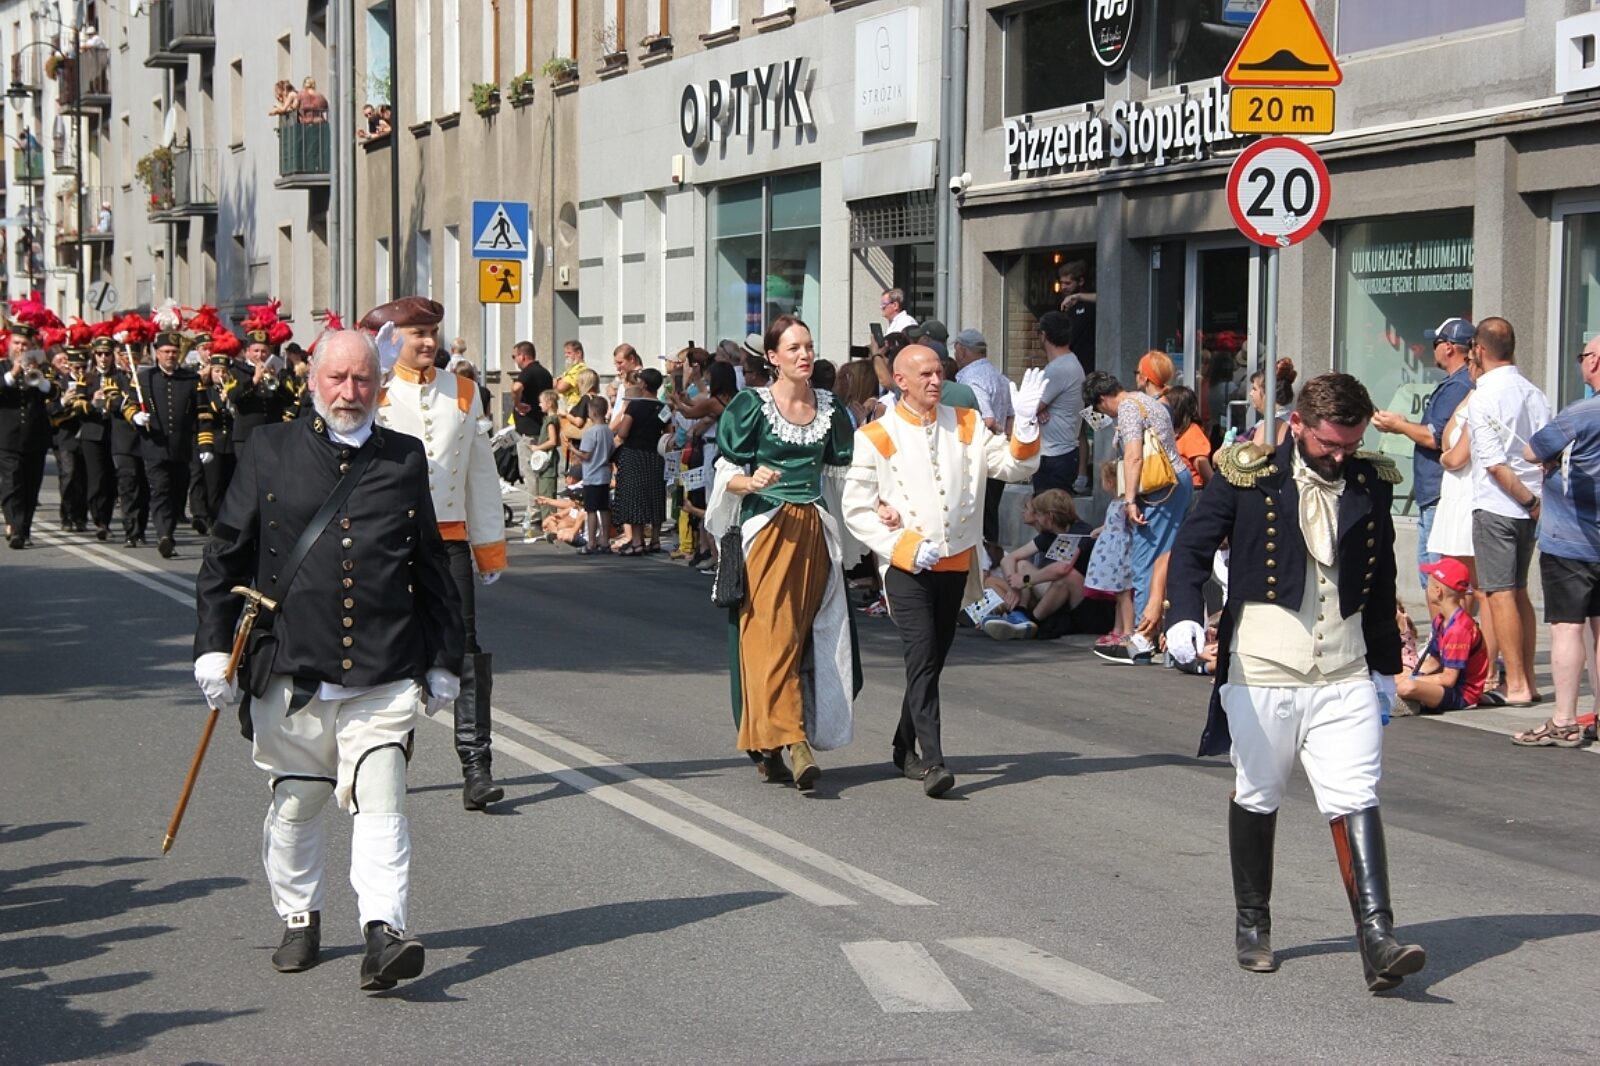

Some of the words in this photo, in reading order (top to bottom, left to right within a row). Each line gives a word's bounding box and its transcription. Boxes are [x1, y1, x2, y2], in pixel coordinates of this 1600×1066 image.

[680, 56, 811, 148] OPTYK
[1248, 97, 1284, 122] 20
[1292, 104, 1314, 122] m
[1003, 104, 1104, 173] Pizzeria
[1111, 76, 1251, 167] Stopiątk
[1246, 166, 1315, 217] 20
[1352, 242, 1412, 273] ODKURZACZE
[88, 289, 117, 304] 20
